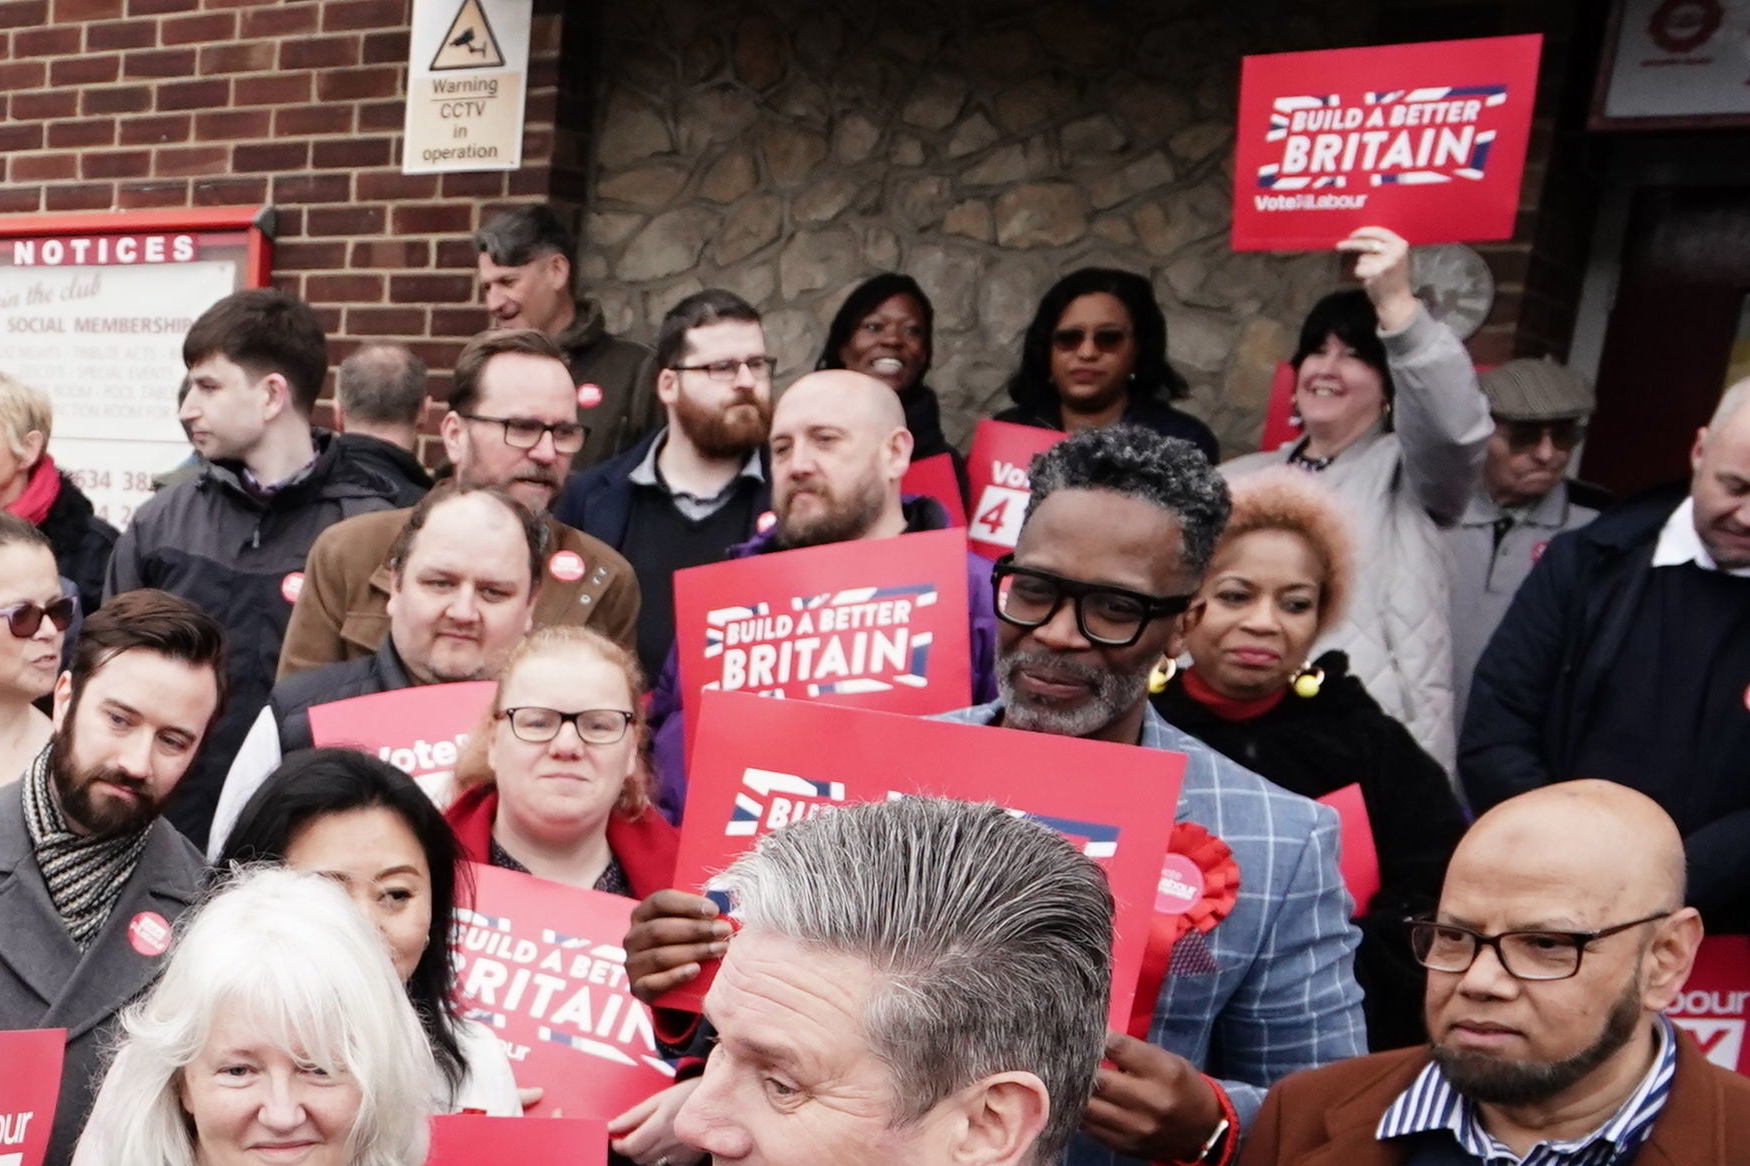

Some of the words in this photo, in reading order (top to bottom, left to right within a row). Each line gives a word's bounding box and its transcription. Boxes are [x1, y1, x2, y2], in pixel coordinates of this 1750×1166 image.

[432, 76, 499, 95] Warning
[440, 101, 486, 119] CCTV
[1291, 106, 1363, 132] BUILD
[1365, 106, 1385, 128] A
[1389, 100, 1482, 127] BETTER
[453, 124, 468, 138] in
[422, 145, 498, 163] operation
[1281, 124, 1476, 174] BRITAIN
[1254, 194, 1297, 211] Vote
[1308, 194, 1368, 209] Labour
[14, 235, 195, 265] NOTICES
[25, 281, 54, 306] the
[60, 273, 102, 300] club
[7, 317, 66, 334] SOCIAL
[979, 497, 1011, 534] 4
[725, 614, 794, 645] BUILD
[796, 615, 815, 634] A
[819, 599, 912, 633] BETTER
[722, 628, 909, 691] BRITAIN
[539, 949, 563, 973] A
